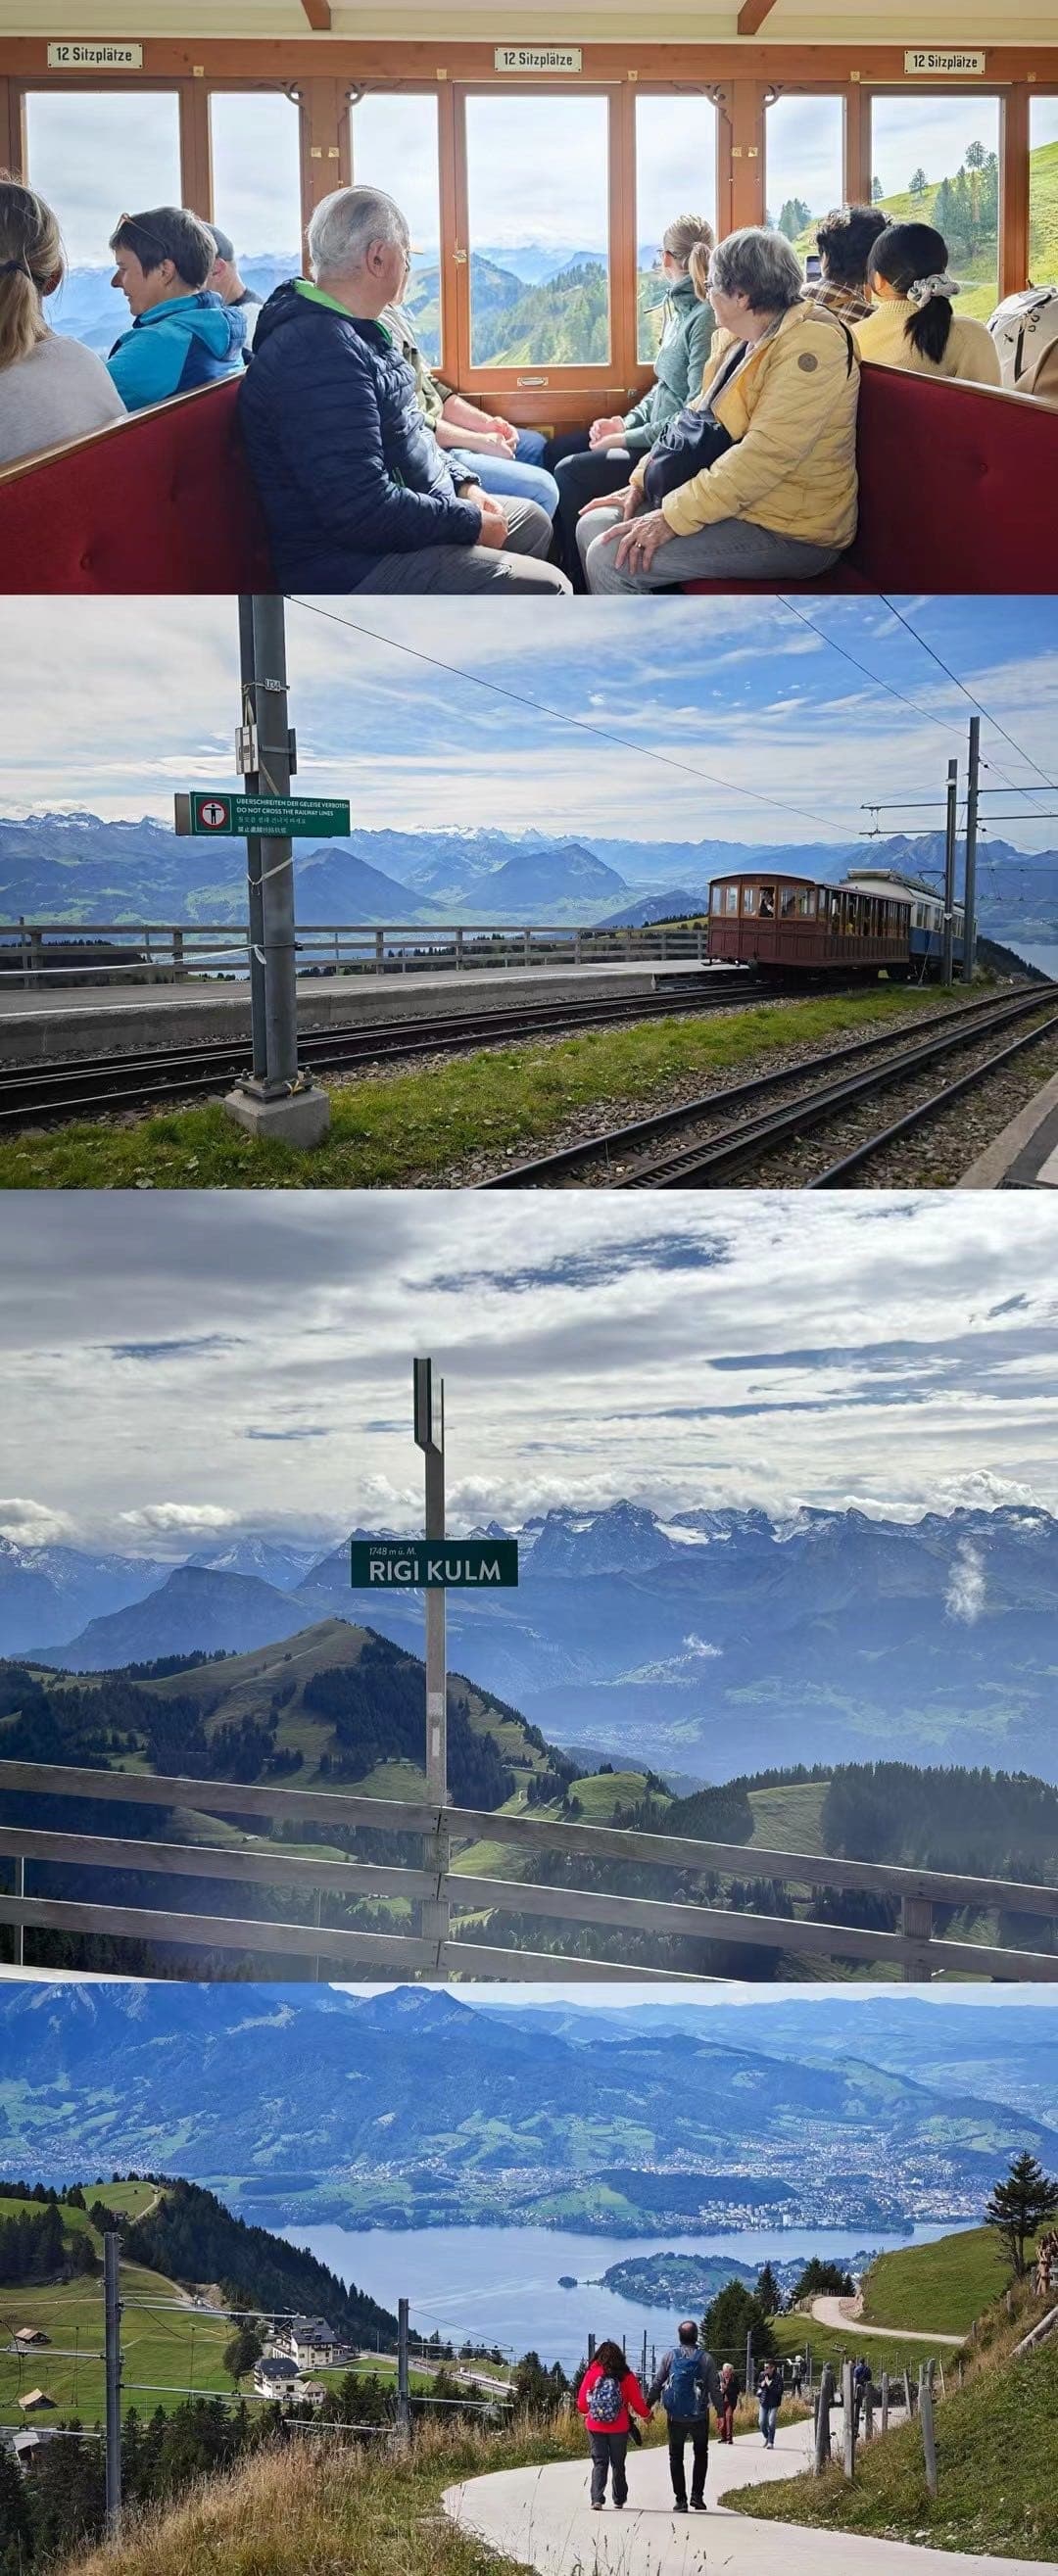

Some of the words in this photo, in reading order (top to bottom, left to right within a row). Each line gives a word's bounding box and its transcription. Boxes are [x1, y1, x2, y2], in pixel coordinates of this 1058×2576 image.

[57, 47, 70, 61] 12
[72, 47, 132, 64] Sitzplätze
[504, 52, 515, 66] 12
[518, 52, 573, 68] Sitzplätze
[913, 55, 926, 68] 12
[928, 55, 978, 70] Sitzplätze
[369, 1560, 419, 1582] RIGI
[427, 1559, 502, 1581] KULM
